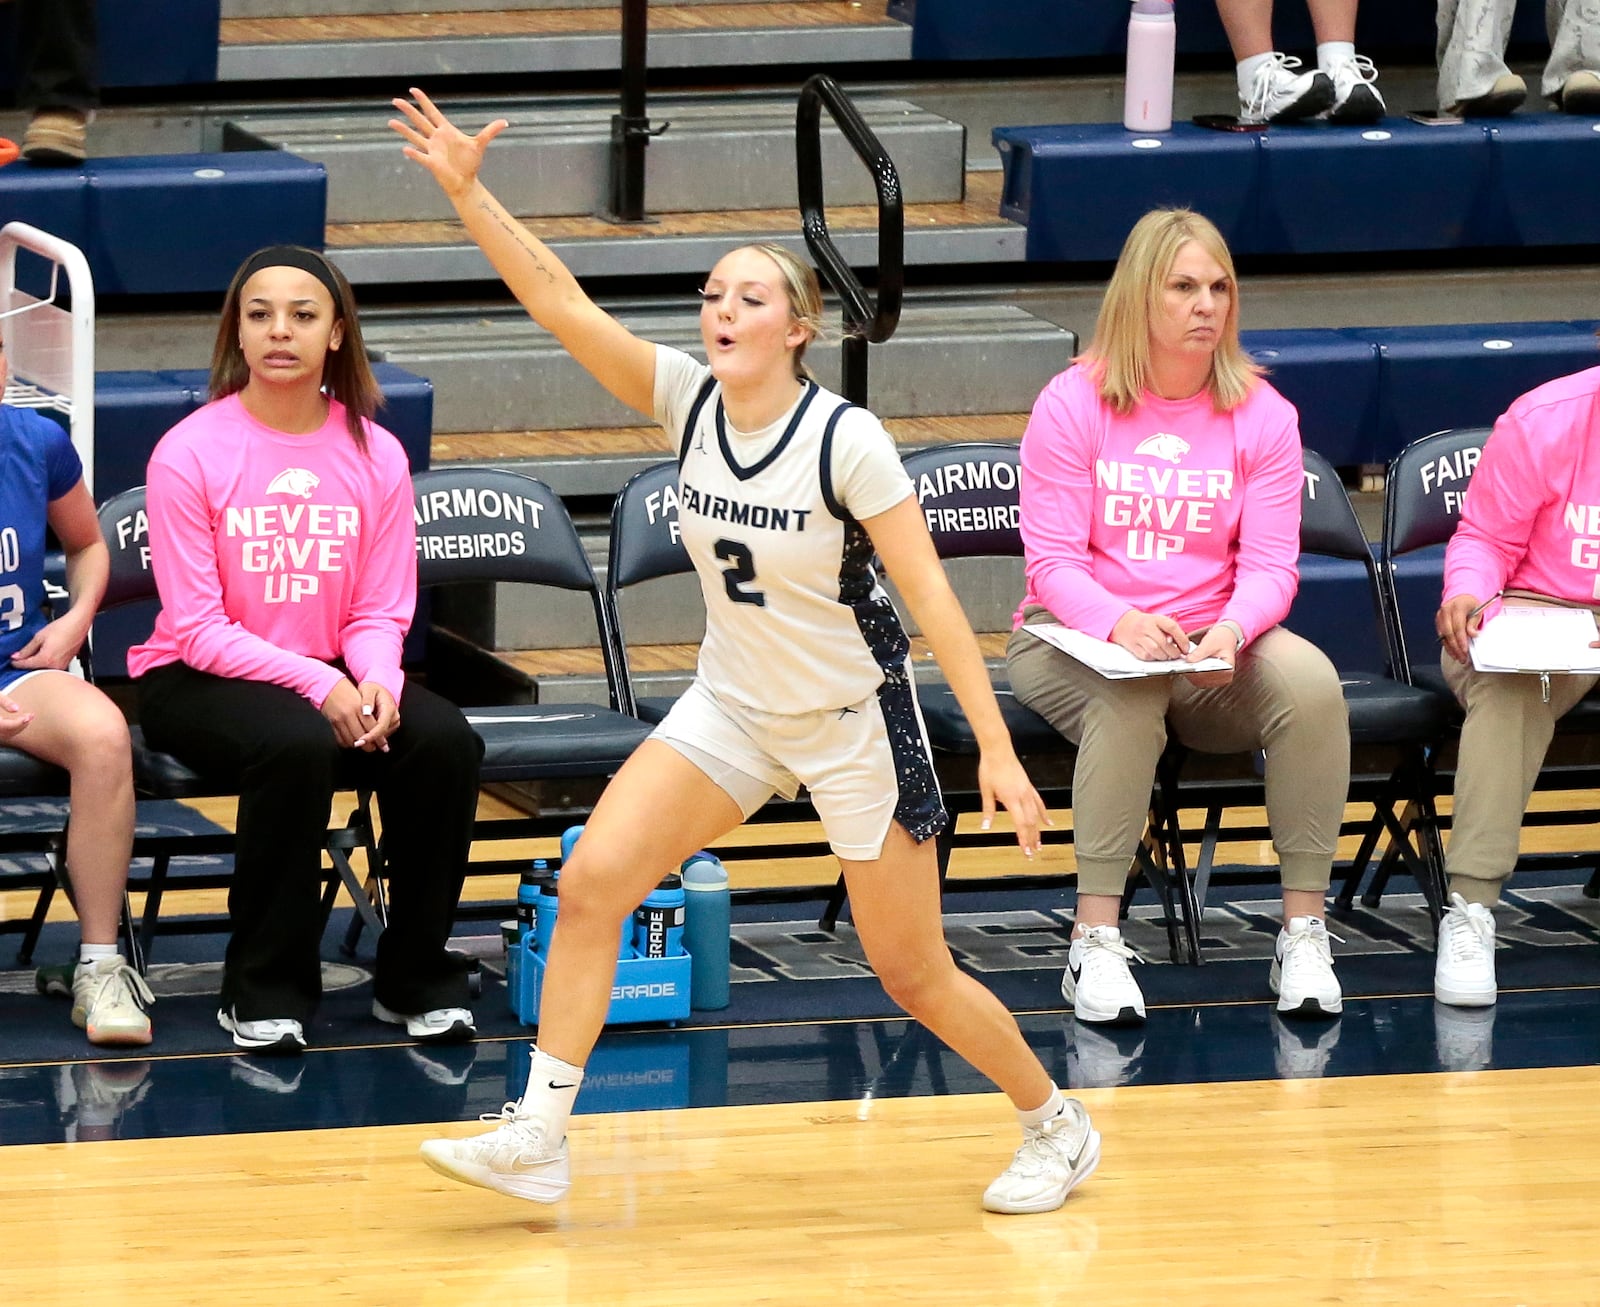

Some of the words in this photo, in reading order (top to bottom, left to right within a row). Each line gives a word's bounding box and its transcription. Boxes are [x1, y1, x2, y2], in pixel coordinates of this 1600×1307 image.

[911, 461, 1021, 505] AIRMO
[1096, 459, 1233, 500] NEVER
[1420, 446, 1486, 495] FAIR
[226, 504, 359, 538] NEVER
[413, 488, 544, 529] IRMONT
[681, 483, 812, 532] FAIRMONT
[925, 505, 1021, 532] FIREBIRD
[1126, 529, 1185, 561] UP
[264, 574, 319, 604] UP
[714, 537, 766, 608] 2
[649, 911, 664, 958] RADE
[611, 982, 676, 1000] ERADE
